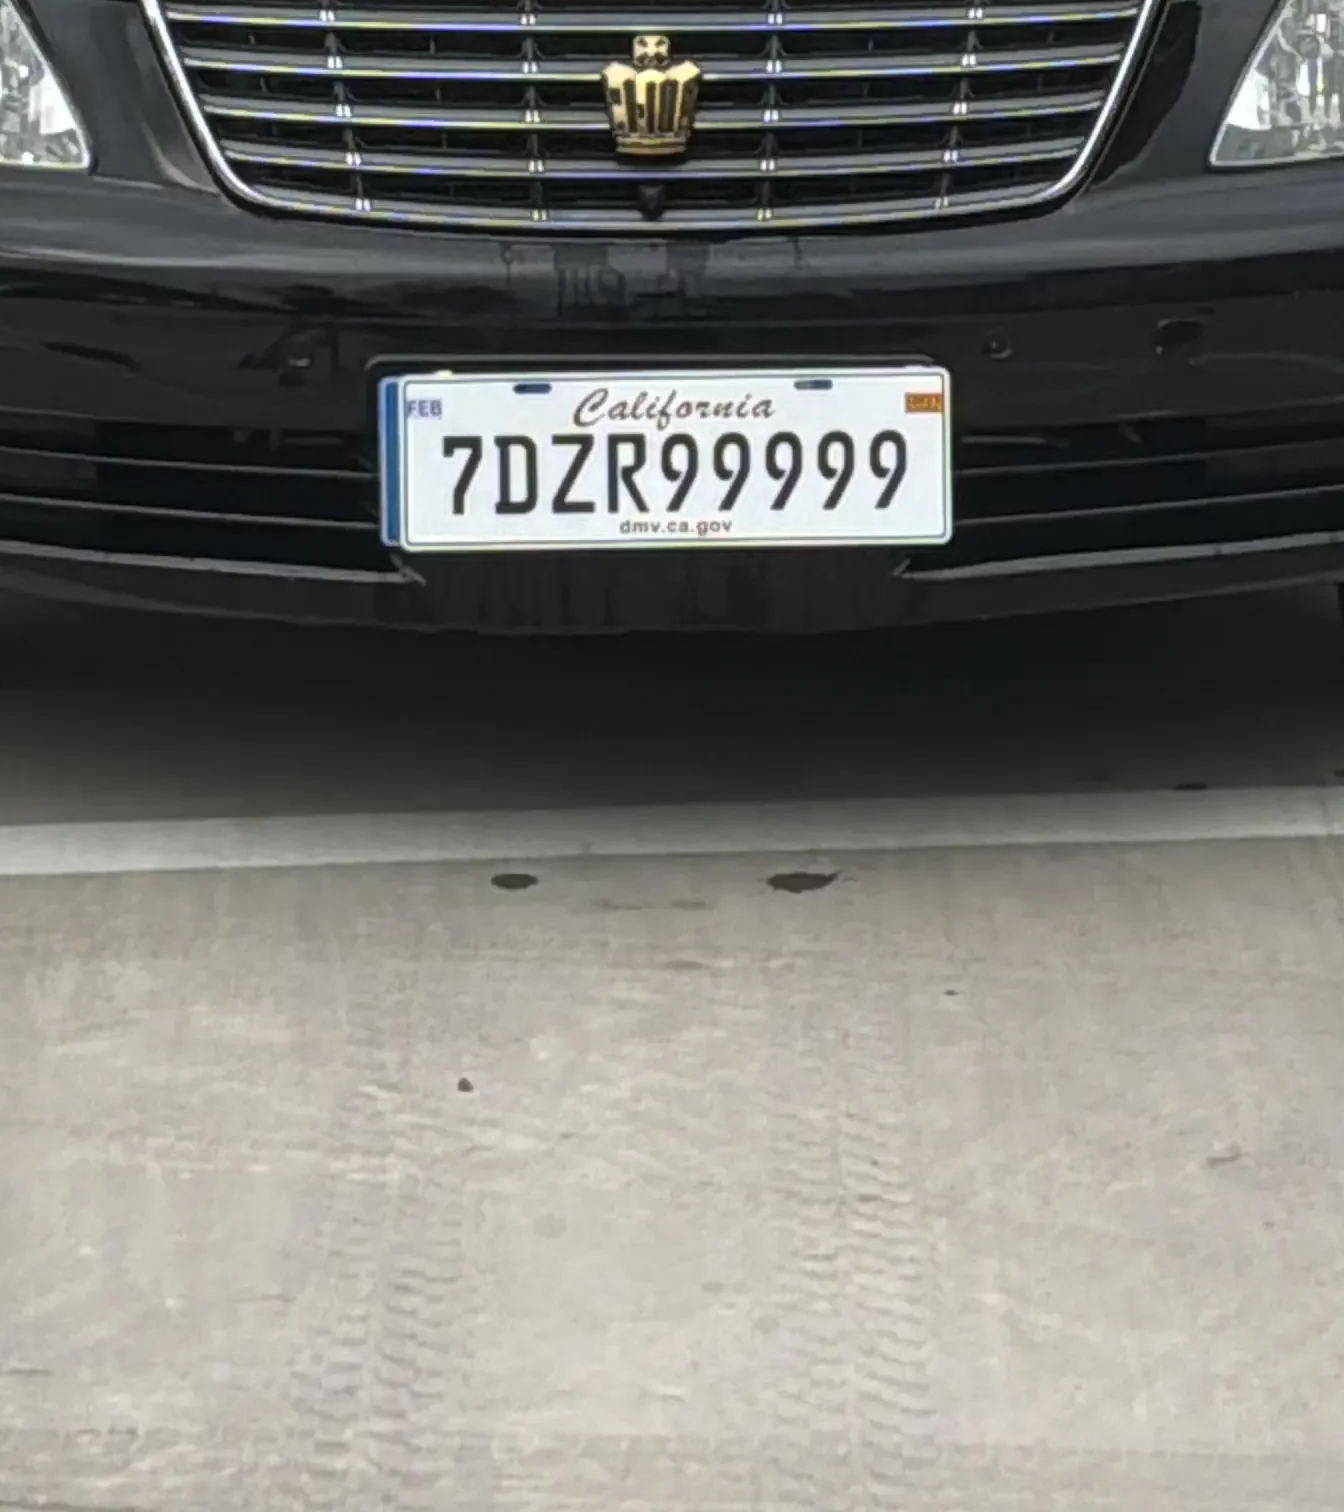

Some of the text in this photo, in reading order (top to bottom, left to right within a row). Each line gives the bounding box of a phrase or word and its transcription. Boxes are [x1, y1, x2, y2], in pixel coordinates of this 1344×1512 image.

[406, 399, 443, 418] FEB
[573, 388, 775, 428] California
[442, 429, 908, 516] 7DZR99999
[619, 518, 733, 536] dmv.ca.gov
